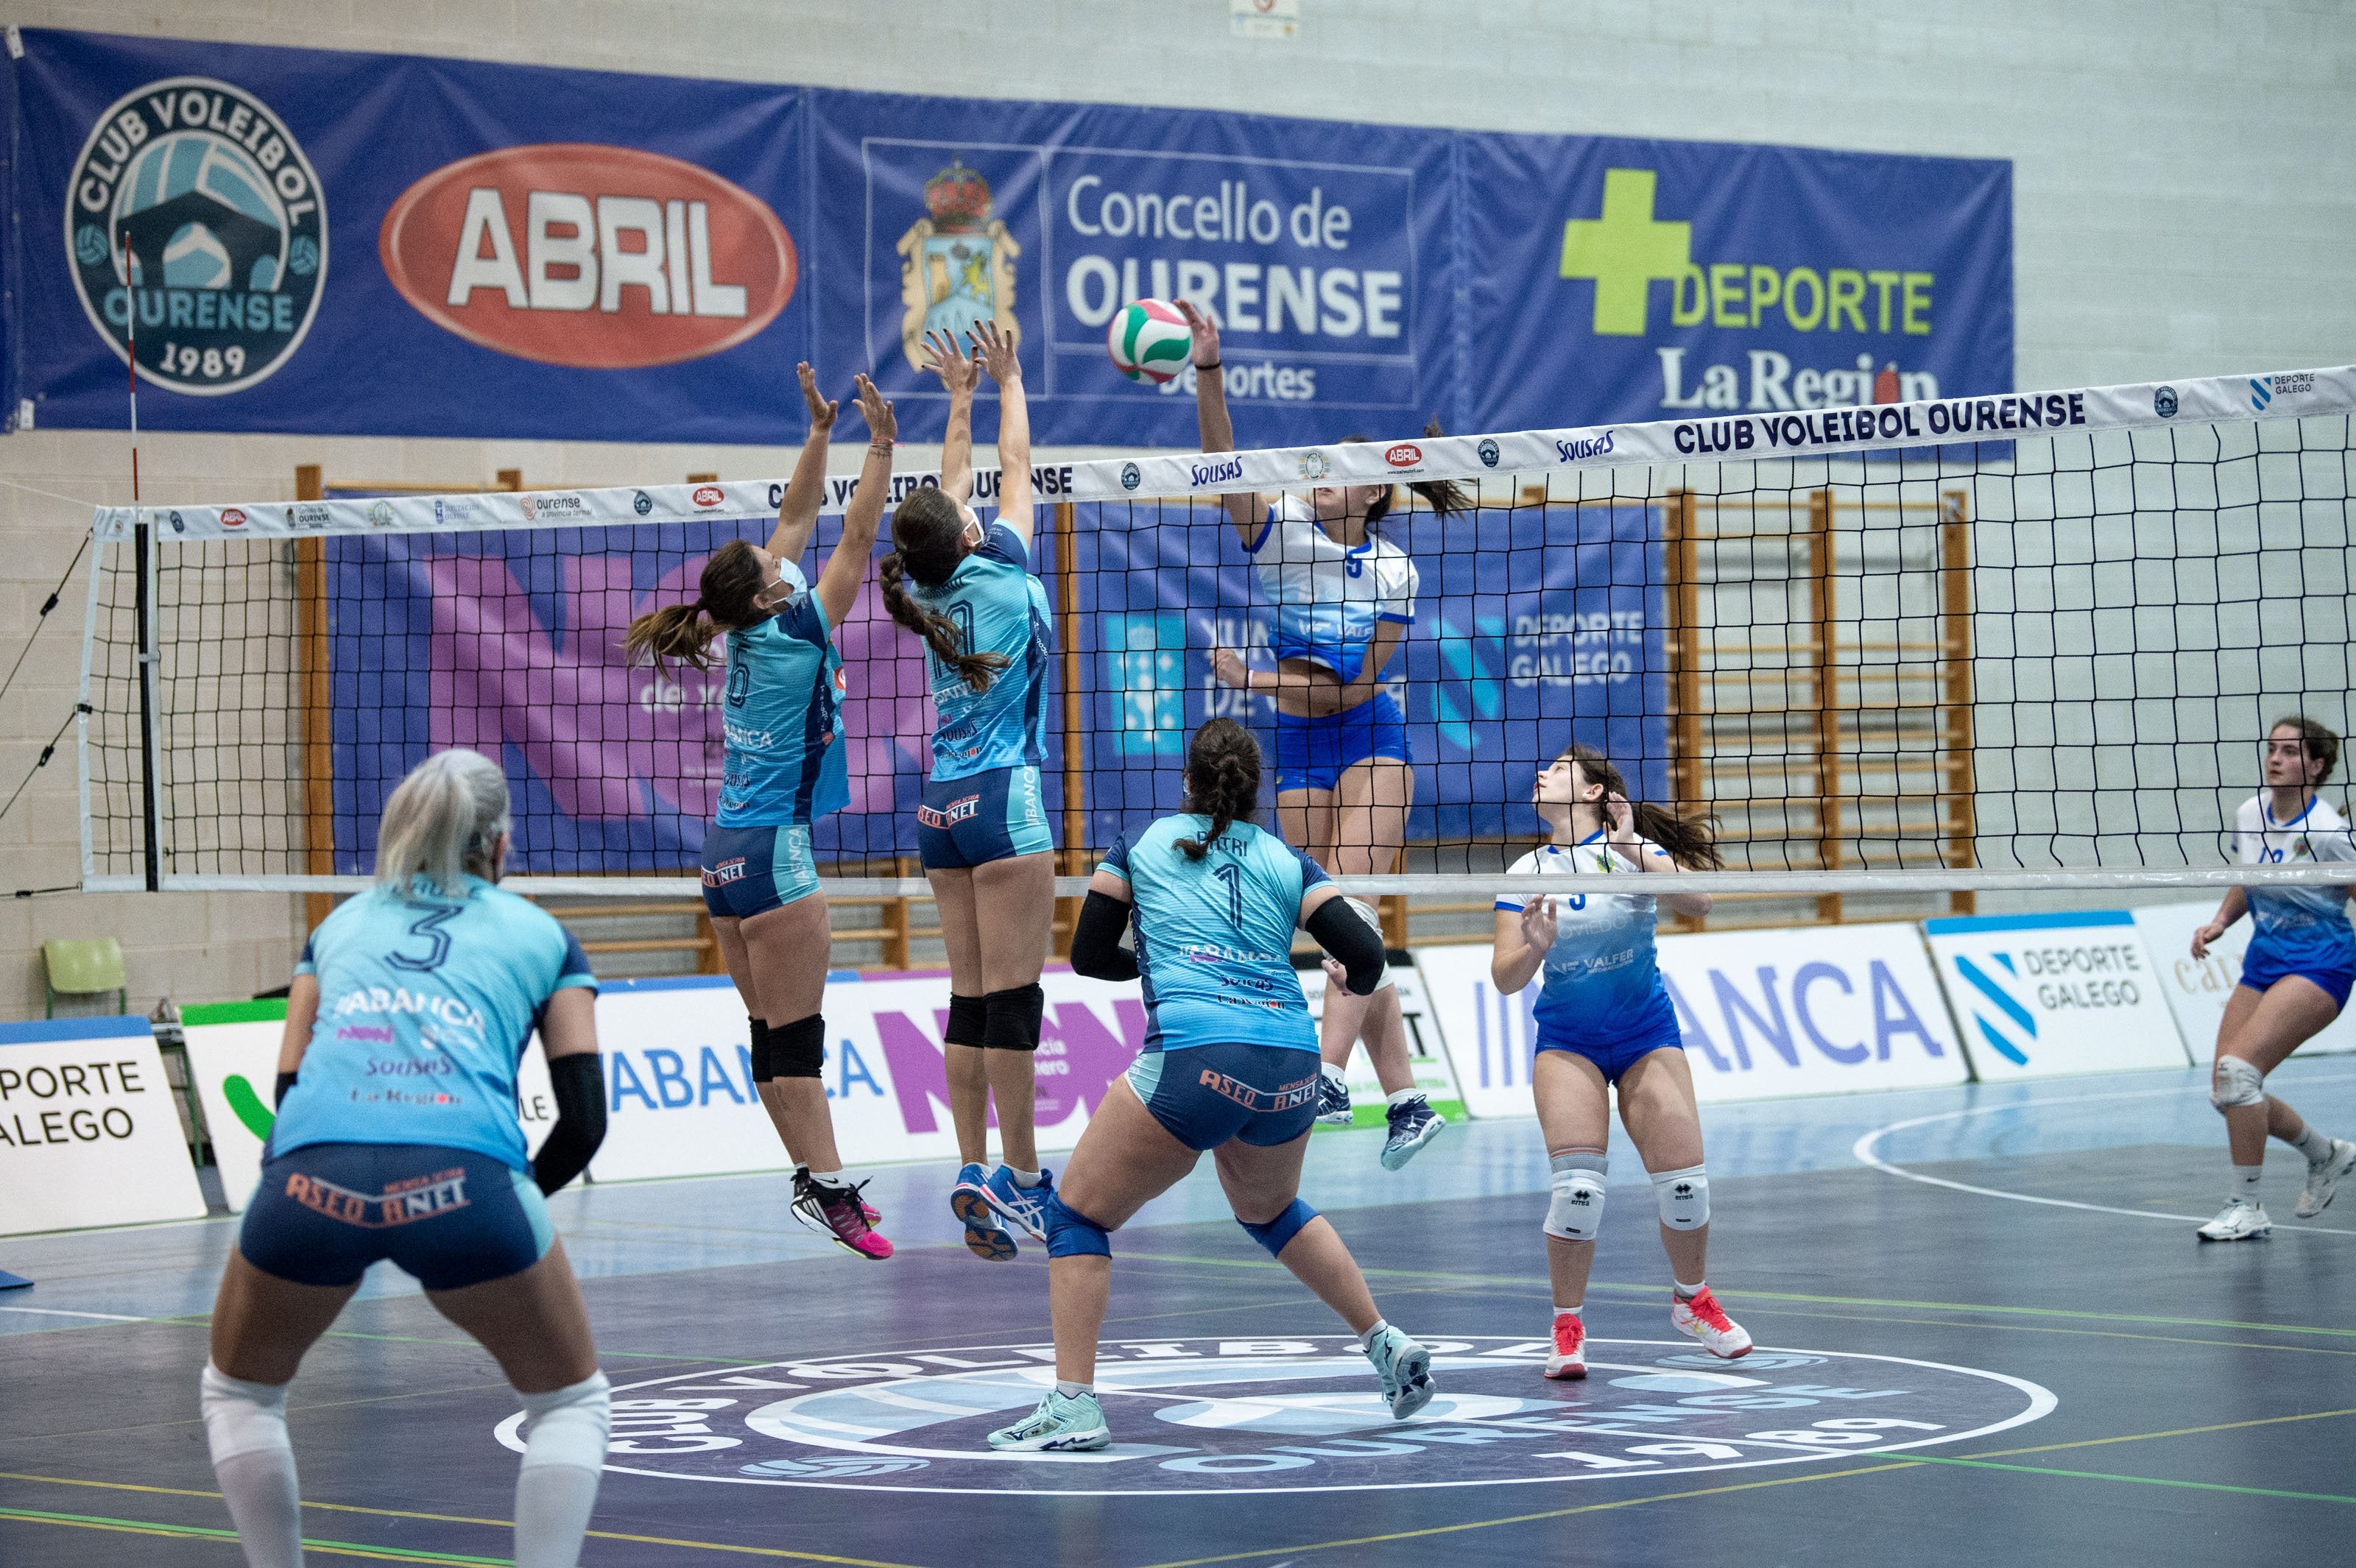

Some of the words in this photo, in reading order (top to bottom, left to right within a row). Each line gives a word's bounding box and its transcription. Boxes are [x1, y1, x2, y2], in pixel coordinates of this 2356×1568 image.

[80, 110, 149, 213] CLUB
[150, 90, 317, 225] VOLEIBOL
[1068, 174, 1282, 246] Concello
[1291, 186, 1352, 250] de
[447, 187, 747, 318] ABRIL
[104, 289, 293, 333] OURENSE
[1066, 255, 1402, 339] OURENSE
[1671, 262, 1934, 336] DEPORTE
[159, 342, 246, 378] 1989
[1657, 347, 1740, 410] La
[1158, 361, 1316, 400] eortes
[2274, 373, 2316, 385] DEPORTE
[2275, 384, 2312, 395] GALEGO
[1673, 420, 1755, 454] CLUB
[1760, 406, 1920, 448] VOLEIBOL
[1928, 393, 2087, 432] OURENSE
[1389, 448, 1420, 462] ABRIL
[1556, 430, 1614, 463] SOUSAS
[1191, 456, 1243, 487] SOUSAS
[536, 497, 580, 510] ourense
[696, 490, 722, 503] ABRIL
[1513, 610, 1644, 648] DEPORTE
[1510, 651, 1632, 688] GALEGO
[640, 677, 686, 713] de
[1213, 863, 1243, 931] 1
[384, 900, 465, 972] 3
[1559, 919, 1627, 939] OVIEDO
[1583, 948, 1634, 969] VALFER
[2024, 944, 2140, 976] DEPORTE
[2038, 979, 2140, 1010] GALEGO
[610, 1038, 884, 1112] ABAA
[1199, 1069, 1258, 1106] ASEO
[1273, 1078, 1319, 1110] ANET
[285, 1172, 364, 1223] ASEO
[1570, 1198, 1590, 1207] errea
[1673, 1193, 1693, 1201] errea
[1158, 1385, 1915, 1474] OURENSE
[1531, 1417, 1948, 1470] 1989
